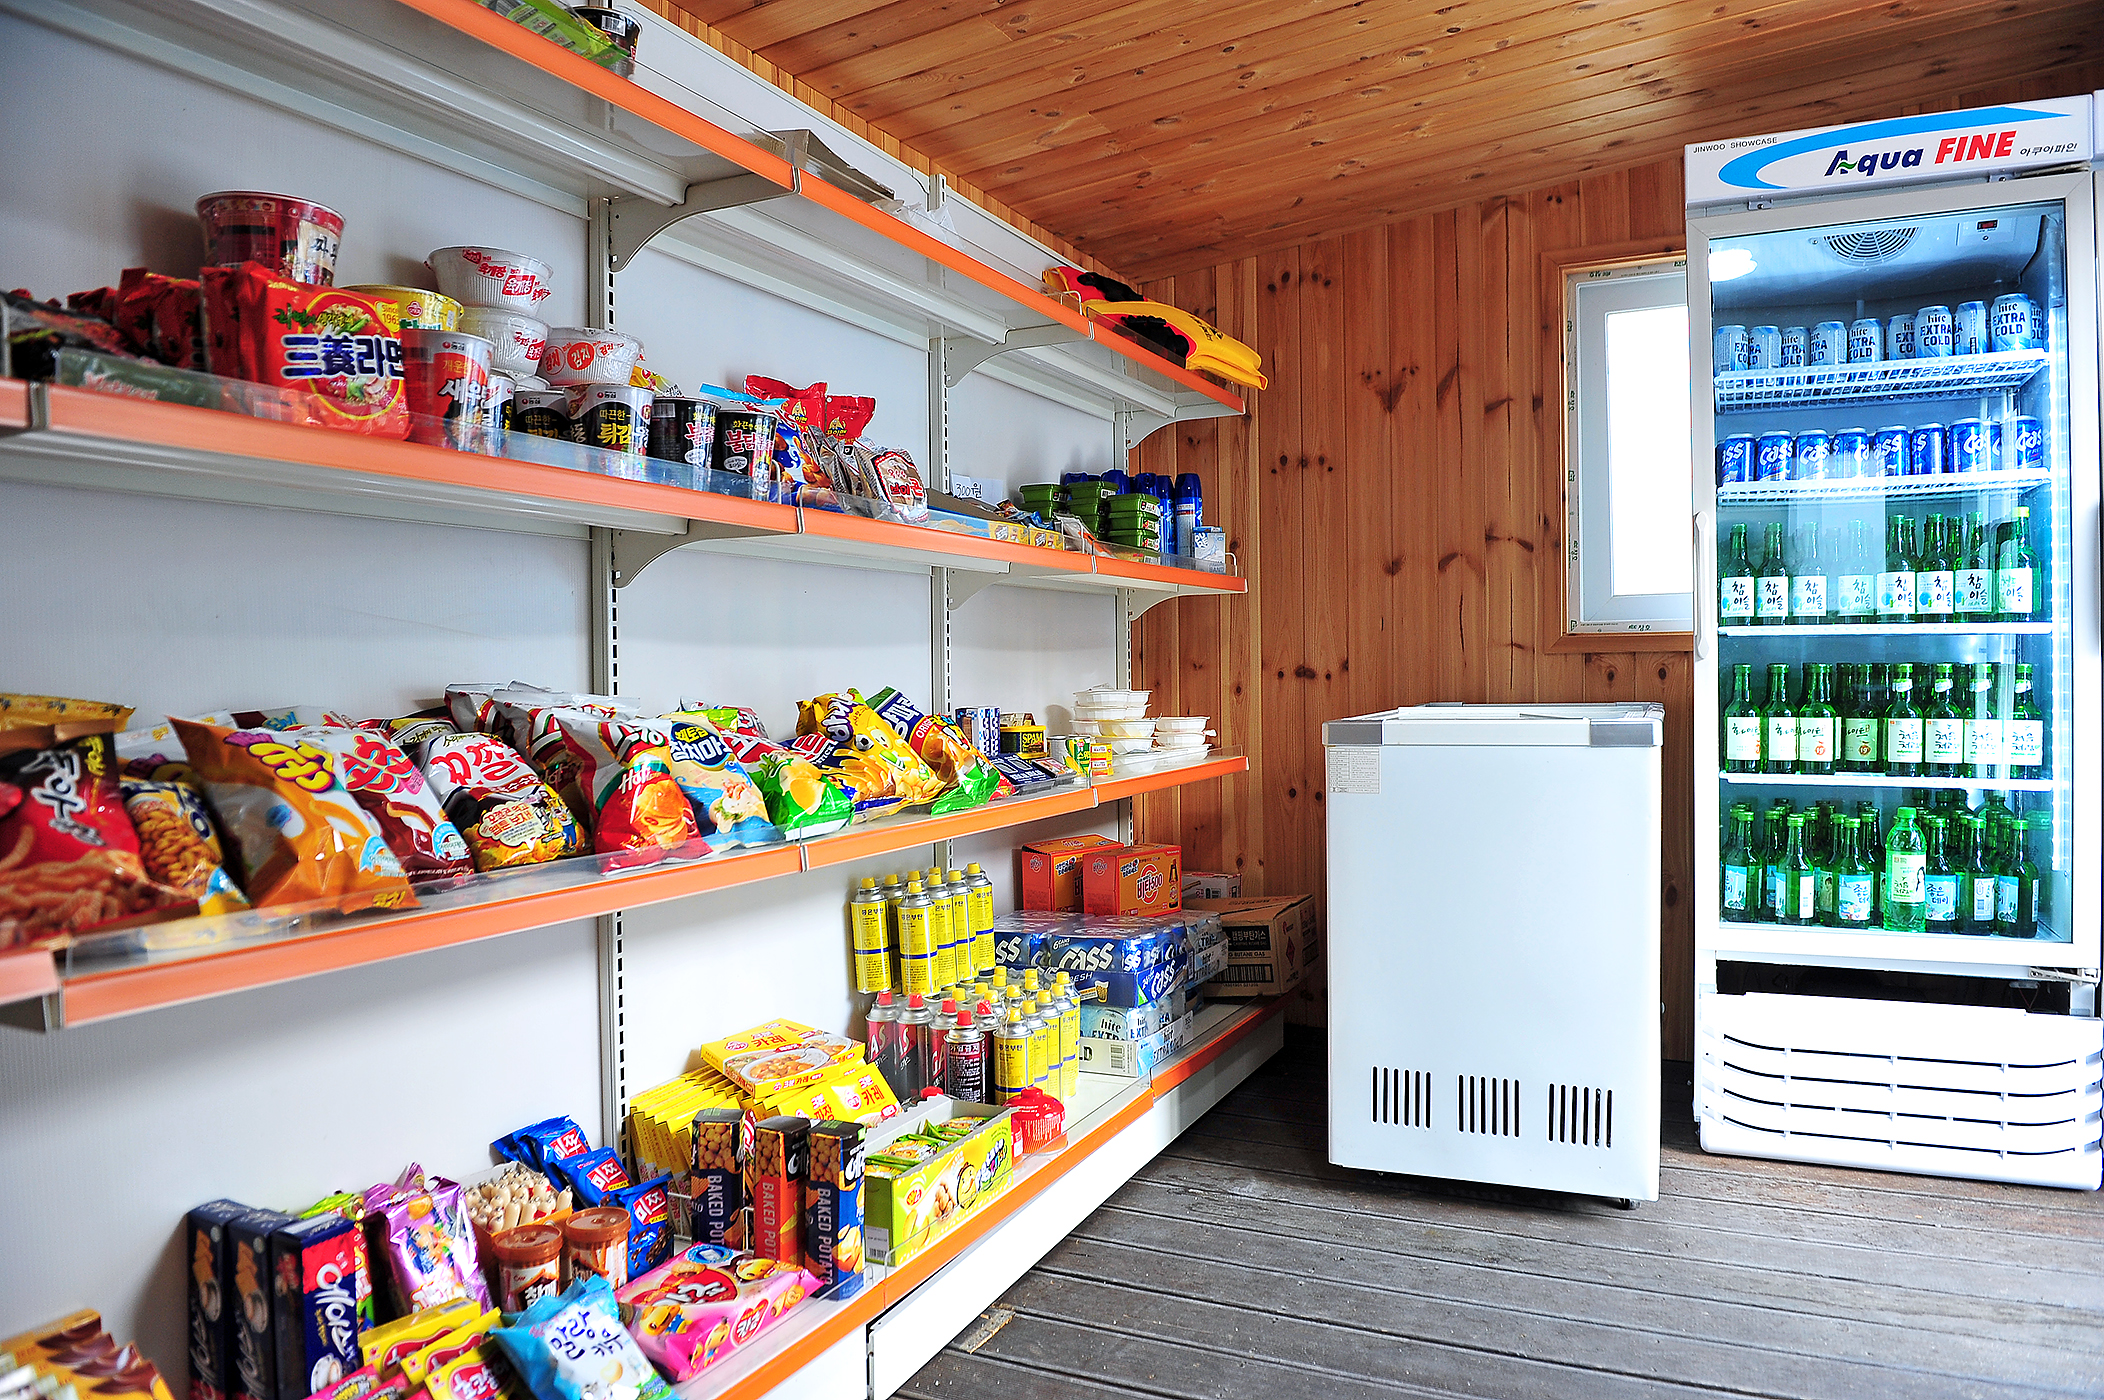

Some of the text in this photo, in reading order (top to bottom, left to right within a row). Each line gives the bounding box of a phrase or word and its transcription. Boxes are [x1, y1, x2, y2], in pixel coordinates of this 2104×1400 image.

[1693, 137, 1778, 153] JINWOO SHOWCASE
[2019, 142, 2078, 157] 아쿠아파인
[1824, 130, 2018, 177] Aqua FINE
[1998, 302, 2018, 313] hite
[1927, 314, 1947, 324] hite
[1992, 311, 2027, 326] EXTRA
[1920, 323, 1953, 336] EXTRA
[1994, 323, 2024, 338] COLD
[1923, 333, 1951, 347] COLD
[571, 345, 591, 368] 김치
[597, 423, 632, 445] 튀김
[955, 482, 983, 499] 300원
[1732, 580, 1746, 596] 참
[1765, 580, 1779, 596] 참
[1805, 579, 1819, 595] 참
[1853, 578, 1867, 594] 참
[1967, 573, 1983, 590] 참
[1733, 595, 1750, 611] 이슬
[1766, 595, 1784, 611] 이슬
[1806, 594, 1824, 610] 이슬
[1855, 593, 1871, 610] 이슬
[1969, 588, 1988, 606] 이슬
[1022, 732, 1044, 746] SPAM
[1926, 883, 1945, 898] 좋은
[1931, 894, 1949, 905] 데이
[1101, 1018, 1122, 1034] hite
[751, 1035, 787, 1048] 카레
[858, 1074, 875, 1089] 3분
[811, 1092, 827, 1109] 3분
[861, 1086, 885, 1106] 카레
[591, 1162, 623, 1188] 미쯔
[707, 1175, 725, 1218] BAKED
[762, 1182, 776, 1226] BAKED
[634, 1189, 667, 1221] 미쯔
[817, 1188, 834, 1286] BAKED POTATO
[549, 1310, 597, 1360] 말랑
[590, 1328, 625, 1357] 카우
